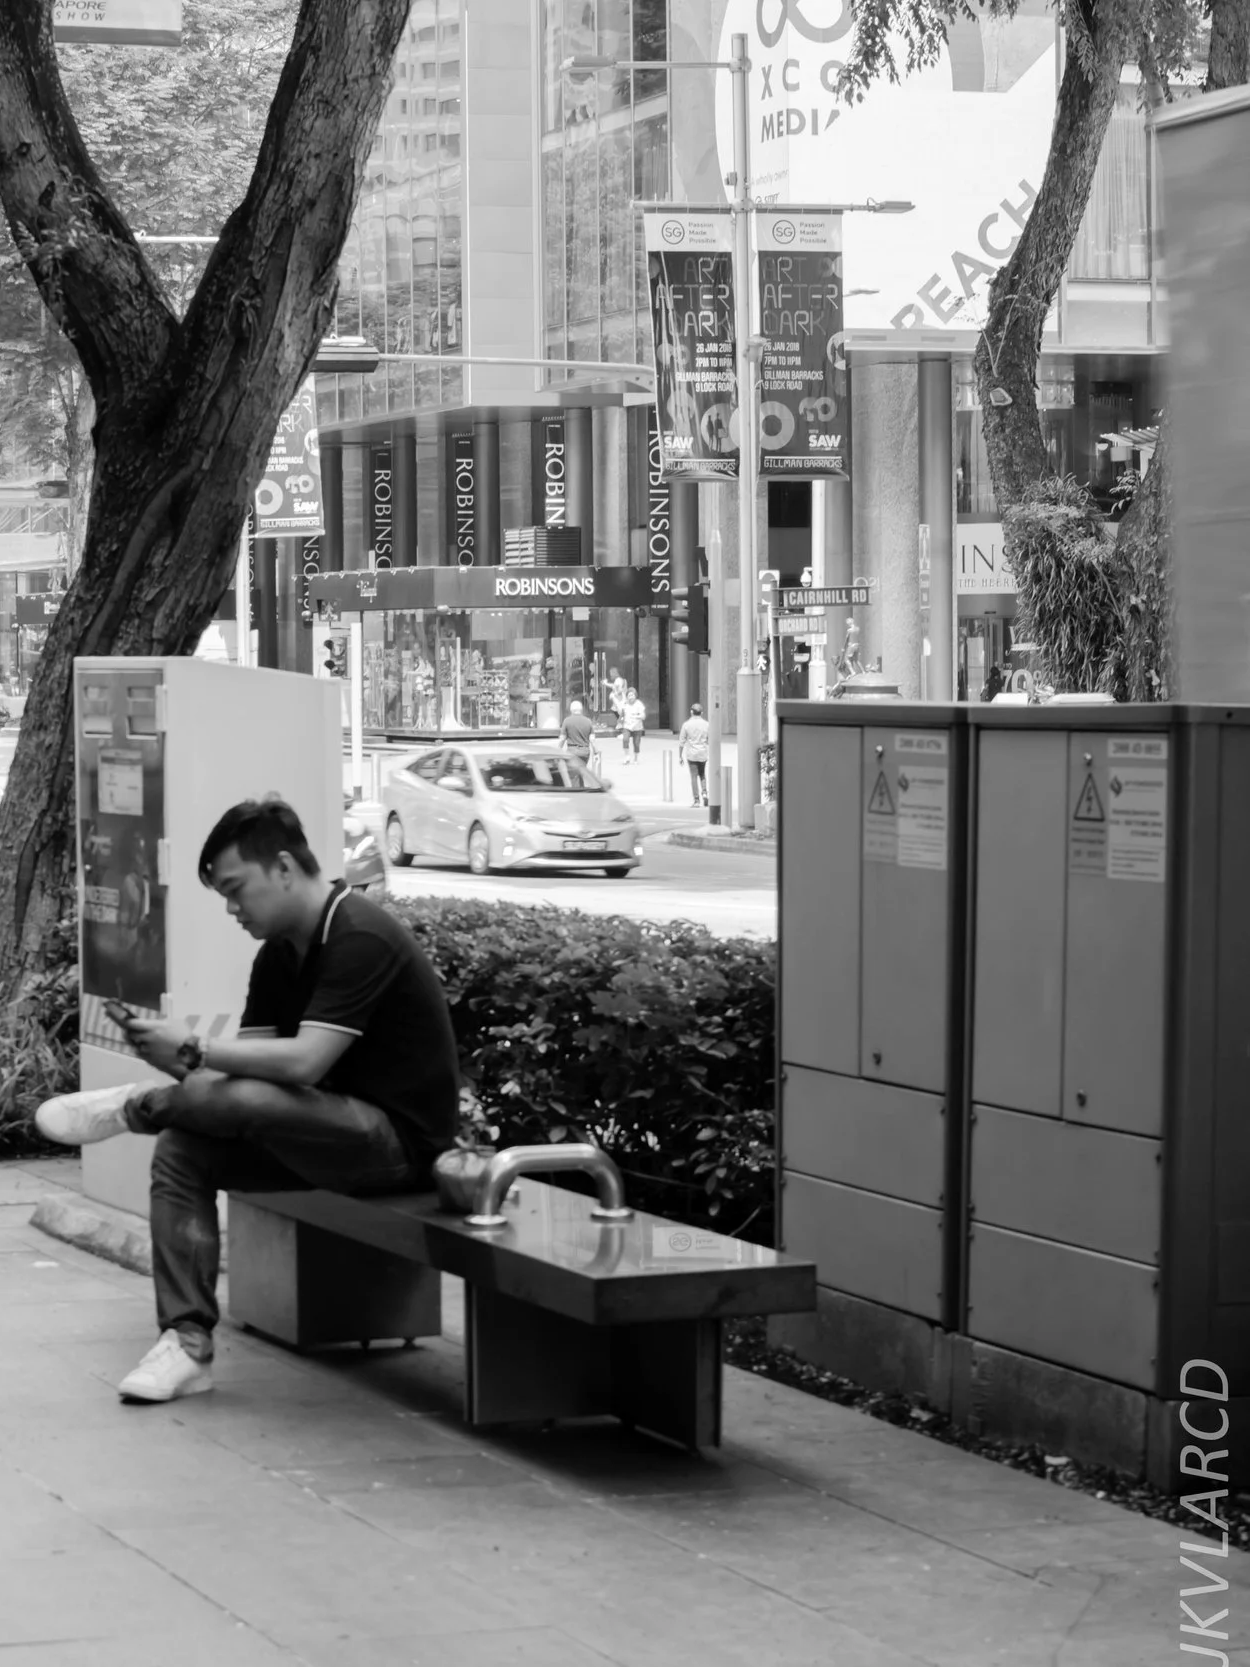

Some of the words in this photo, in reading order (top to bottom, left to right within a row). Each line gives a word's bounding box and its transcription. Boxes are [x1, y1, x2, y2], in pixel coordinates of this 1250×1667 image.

[664, 227, 682, 238] SG
[775, 226, 793, 238] SG
[763, 284, 839, 310] AFTER
[763, 310, 827, 336] DARK
[705, 343, 718, 353] JAN
[773, 342, 785, 352] JAN
[786, 342, 800, 352] 2018
[764, 356, 777, 366] 7PM
[778, 356, 786, 366] TO
[787, 356, 801, 366] 11PM
[764, 370, 790, 380] GILLMAN
[791, 370, 824, 381] BARRACKS
[770, 381, 786, 391] LOCK
[787, 381, 803, 391] ROAD
[663, 436, 694, 449] SAW
[809, 434, 842, 448] SAW
[763, 460, 803, 468] GILLMAN
[293, 502, 319, 512] SAW
[495, 577, 595, 596] ROBINSONS
[789, 589, 849, 606] CAIRNHILL
[851, 589, 867, 603] RD
